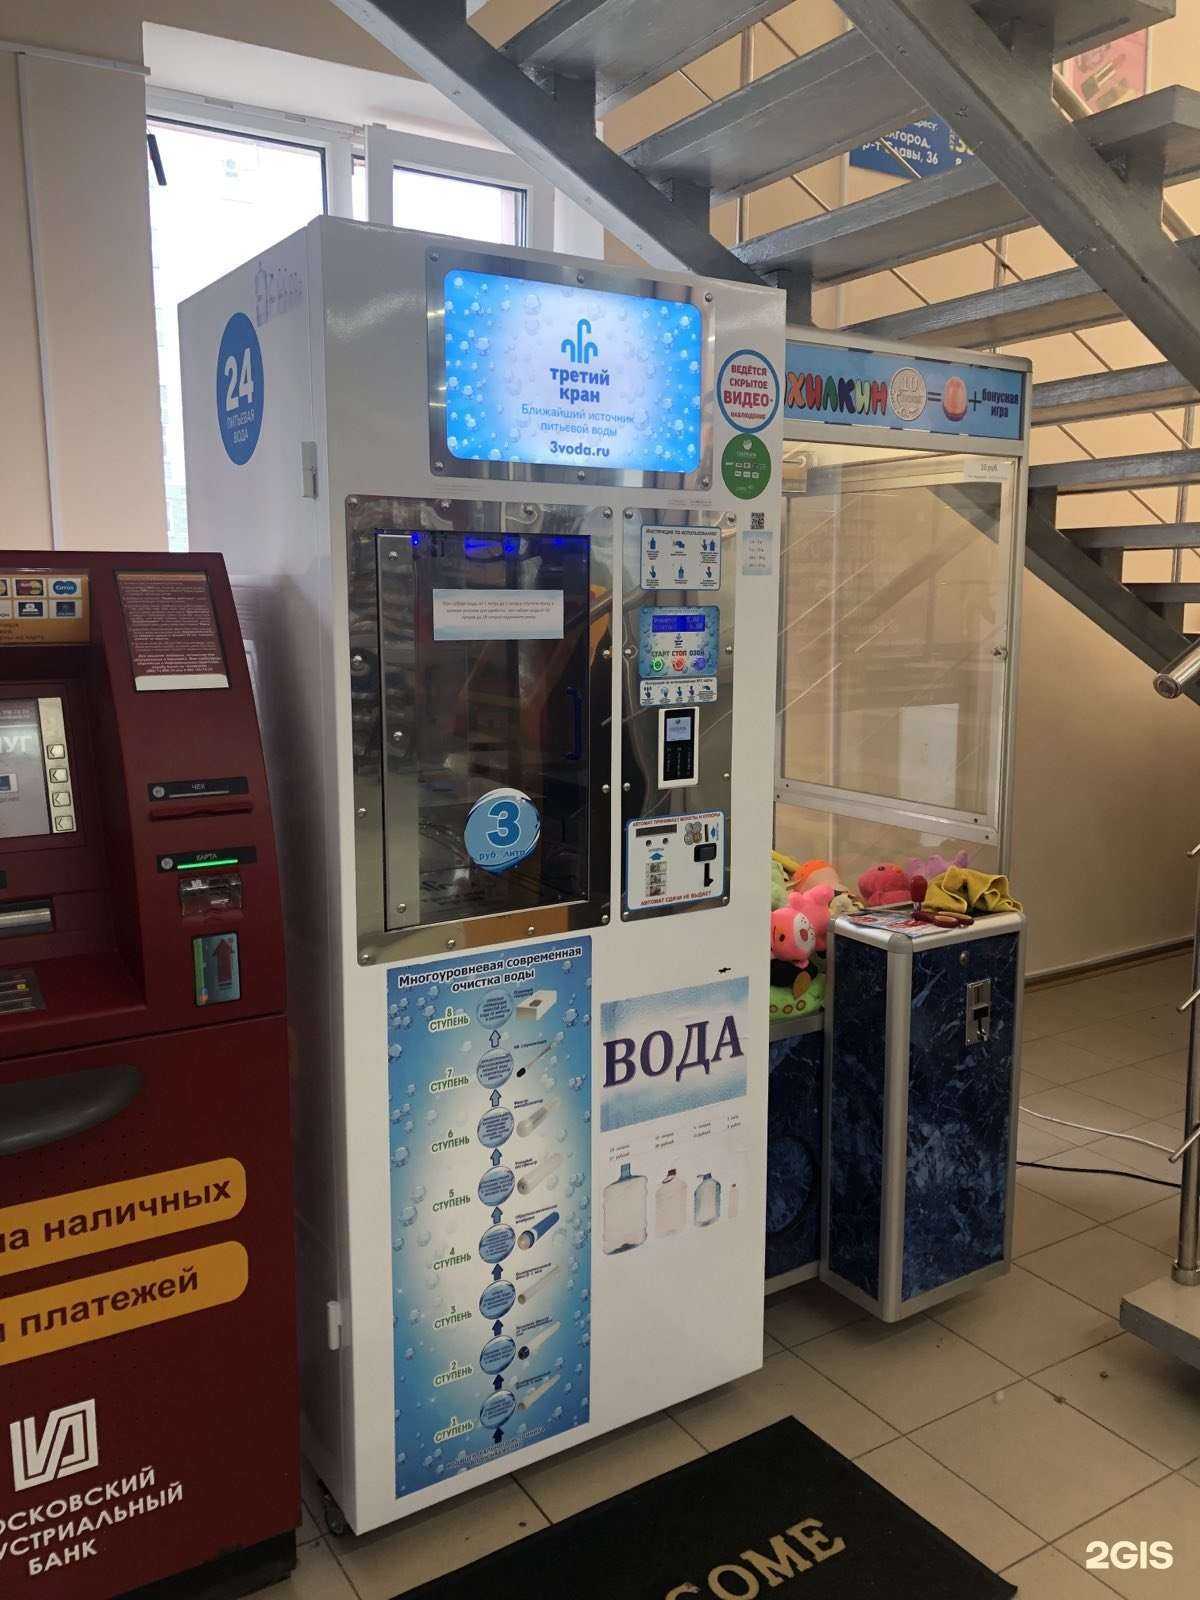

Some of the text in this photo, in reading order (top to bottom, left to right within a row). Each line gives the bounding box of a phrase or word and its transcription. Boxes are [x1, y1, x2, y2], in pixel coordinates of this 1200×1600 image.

[926, 151, 938, 165] 36
[550, 367, 610, 387] третий
[731, 364, 767, 376] ВЕДЁТСЯ
[224, 347, 254, 412] 24
[730, 378, 768, 389] СКРЫТОЕ
[559, 387, 600, 405] кран
[723, 391, 773, 408] ВИДЕО-
[784, 371, 888, 416] ХИЛКИН
[982, 388, 1019, 404] бонусная
[521, 404, 635, 424] Ближайший источник
[991, 405, 1008, 418] игра
[233, 428, 249, 444] ВОДА
[541, 421, 618, 438] питьевой воды
[550, 440, 610, 457] 3voda.ru
[486, 800, 522, 848] 3
[640, 897, 664, 906] АВТОМАТ
[399, 946, 582, 988] Многоуровневая современная
[452, 968, 535, 993] очистка воды
[446, 1008, 453, 1017] 8
[429, 1016, 469, 1031] СТУПЕНЬ
[602, 1015, 744, 1088] ВОДА
[447, 1069, 453, 1078] 7
[430, 1076, 469, 1092] СТУПЕНЬ
[448, 1129, 454, 1138] 6
[431, 1136, 470, 1152] СТУПЕНЬ
[449, 1189, 455, 1198] 5
[44, 1180, 232, 1242] наличных
[432, 1195, 471, 1212] СТУПЕНЬ
[449, 1247, 455, 1256] 4
[433, 1253, 472, 1271] СТУПЕНЬ
[20, 1265, 198, 1337] платежей
[450, 1305, 456, 1314] 3
[434, 1311, 472, 1329] СТУПЕНЬ
[451, 1361, 457, 1370] 2
[435, 1367, 472, 1385] СТУПЕНЬ
[451, 1418, 457, 1428] 1
[435, 1422, 473, 1442] СТУПЕНЬ
[29, 1539, 98, 1576] БАНК
